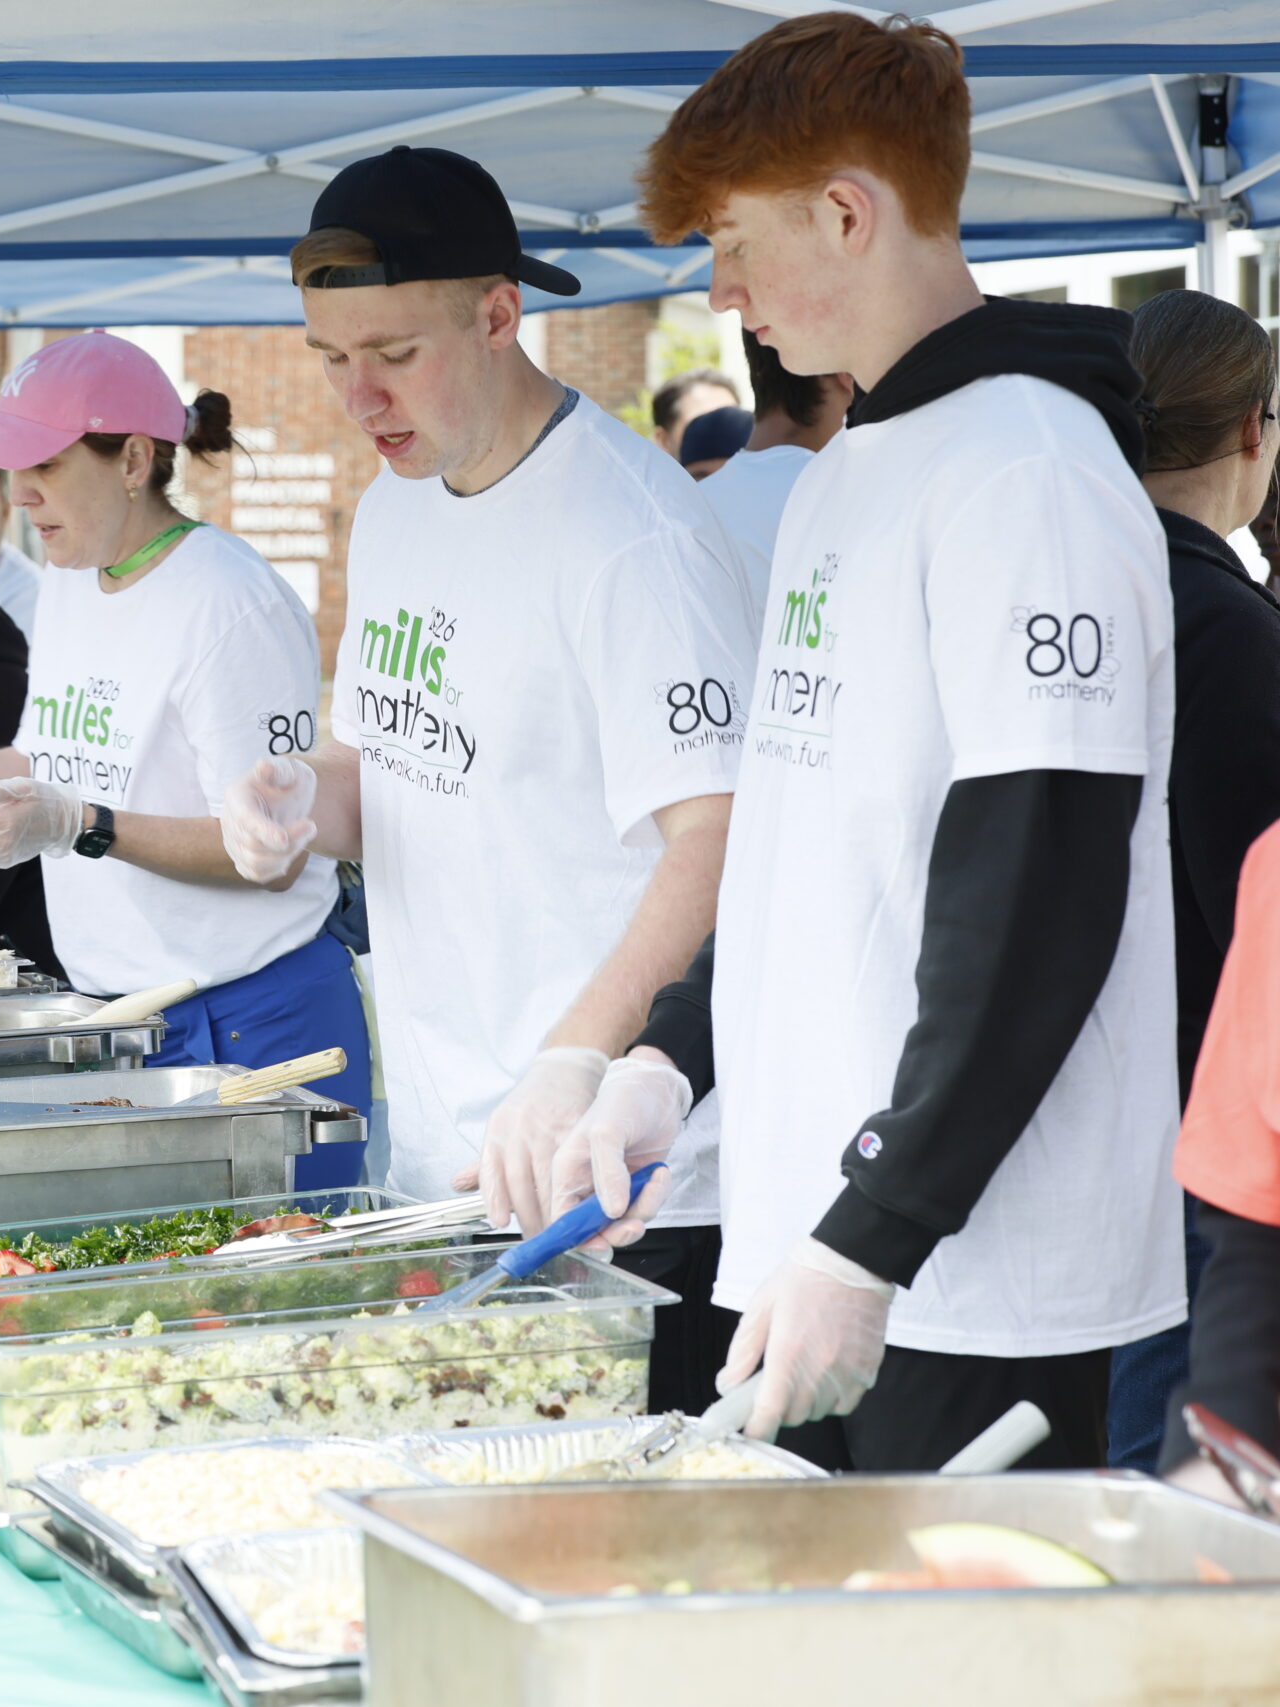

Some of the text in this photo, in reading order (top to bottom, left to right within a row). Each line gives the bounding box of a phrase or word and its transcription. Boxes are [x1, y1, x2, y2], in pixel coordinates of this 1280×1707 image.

[1026, 613, 1102, 678] 80
[268, 709, 314, 756] 80
[666, 677, 732, 735] 80
